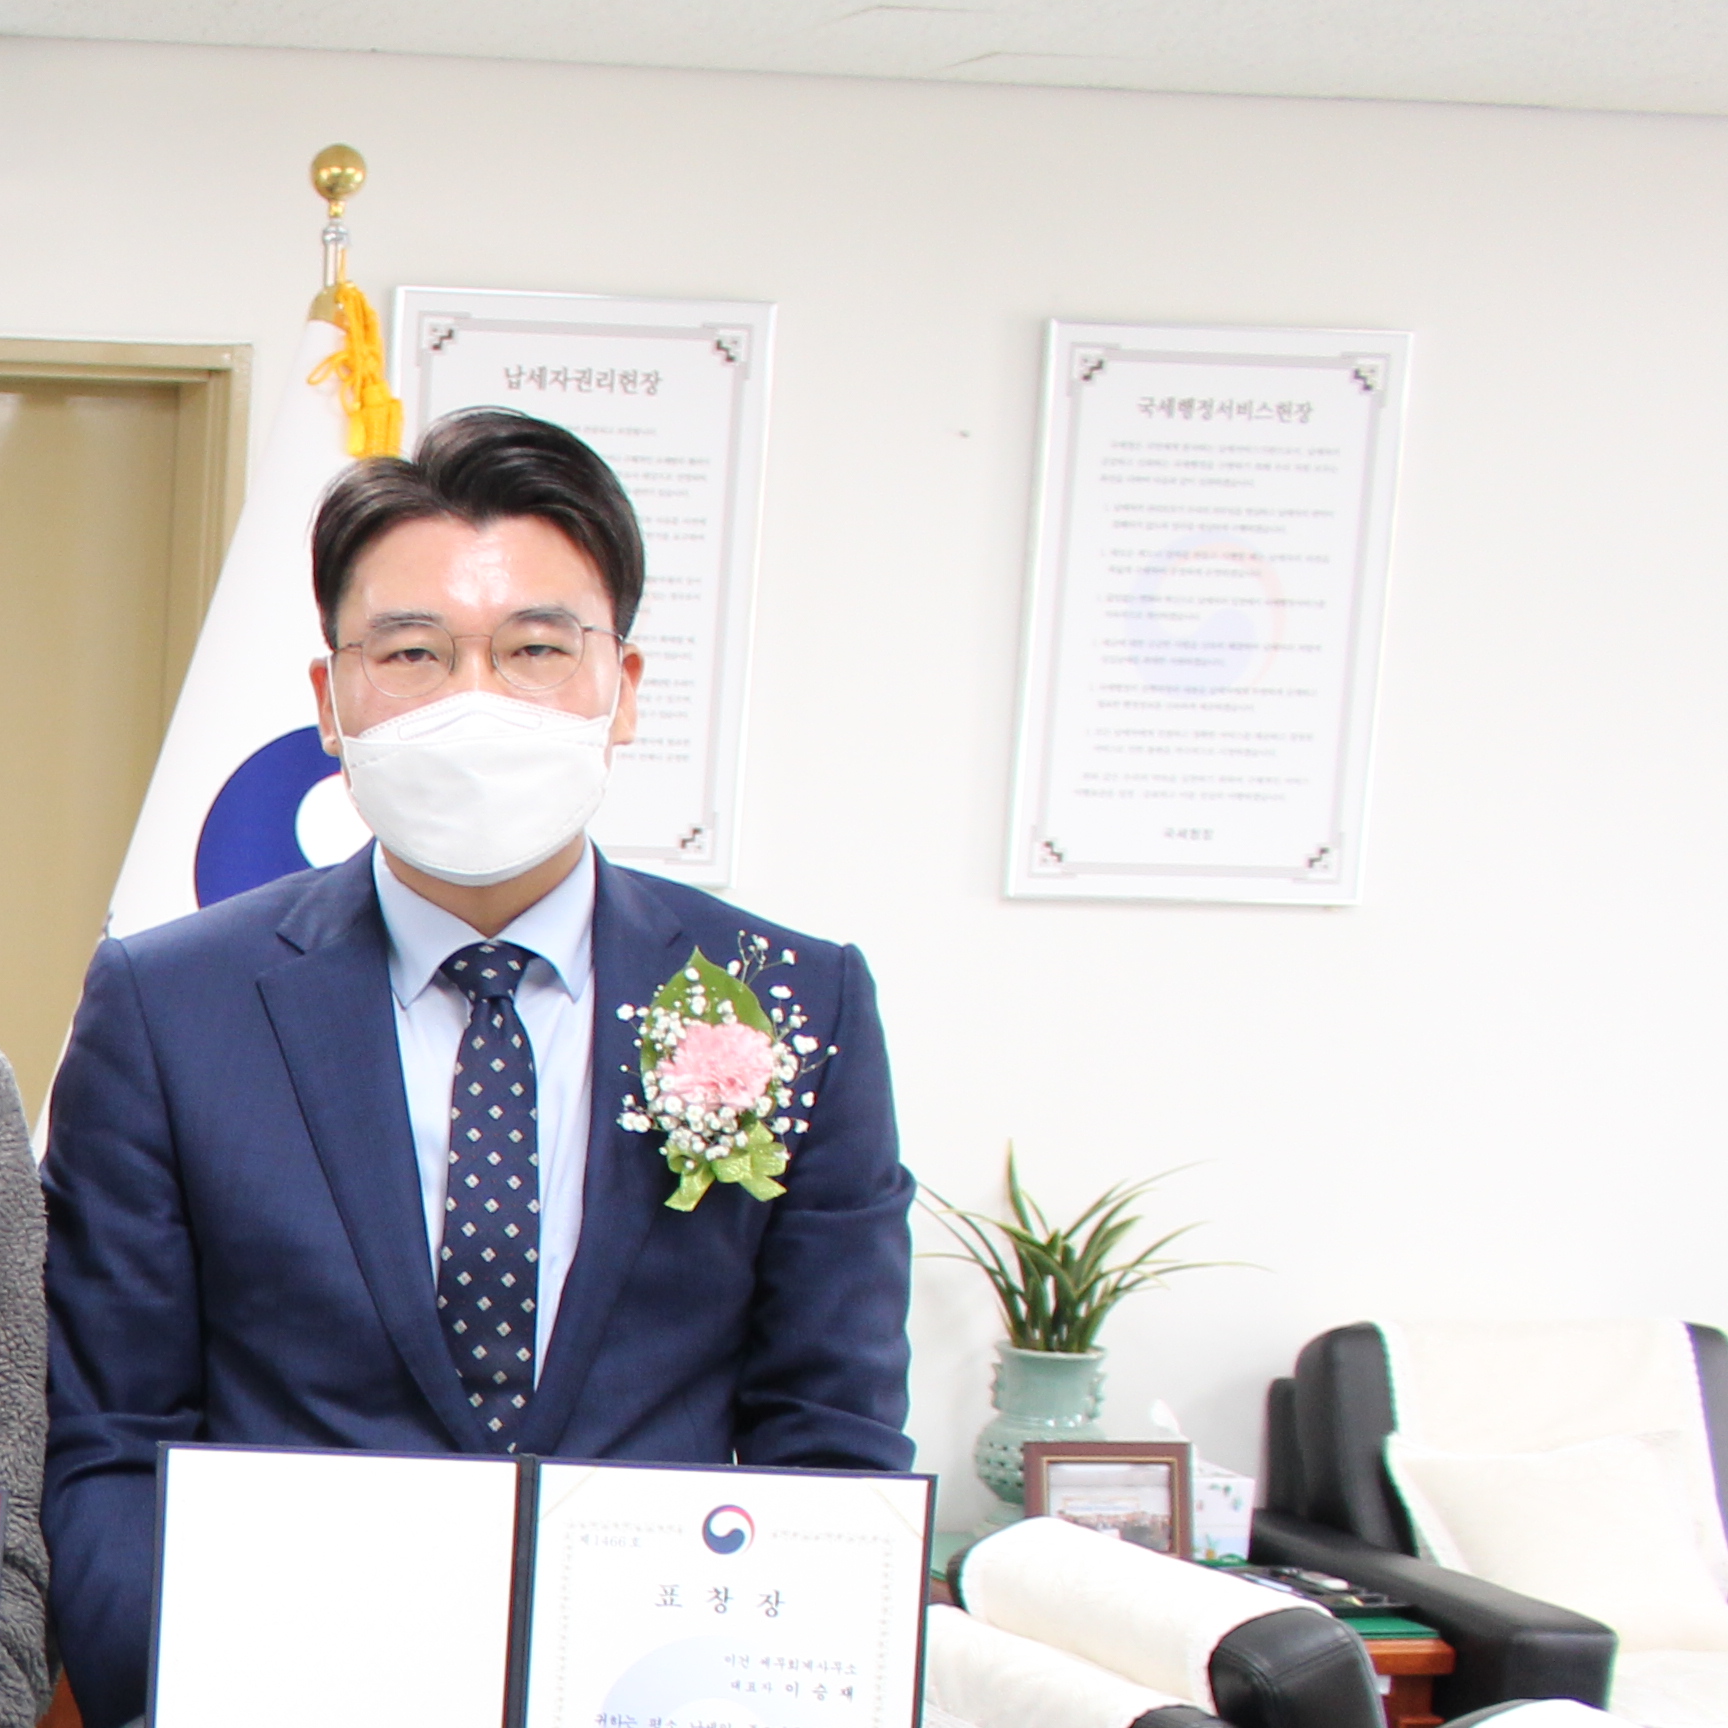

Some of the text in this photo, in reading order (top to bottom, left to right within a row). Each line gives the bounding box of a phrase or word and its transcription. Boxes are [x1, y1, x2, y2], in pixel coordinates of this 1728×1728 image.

[503, 364, 663, 397] 납세자권리헌장
[1137, 395, 1314, 424] 국세행정서비스헌장
[594, 1534, 627, 1548] 1466
[654, 1584, 784, 1618] 표창장
[730, 1679, 773, 1694] 대표자
